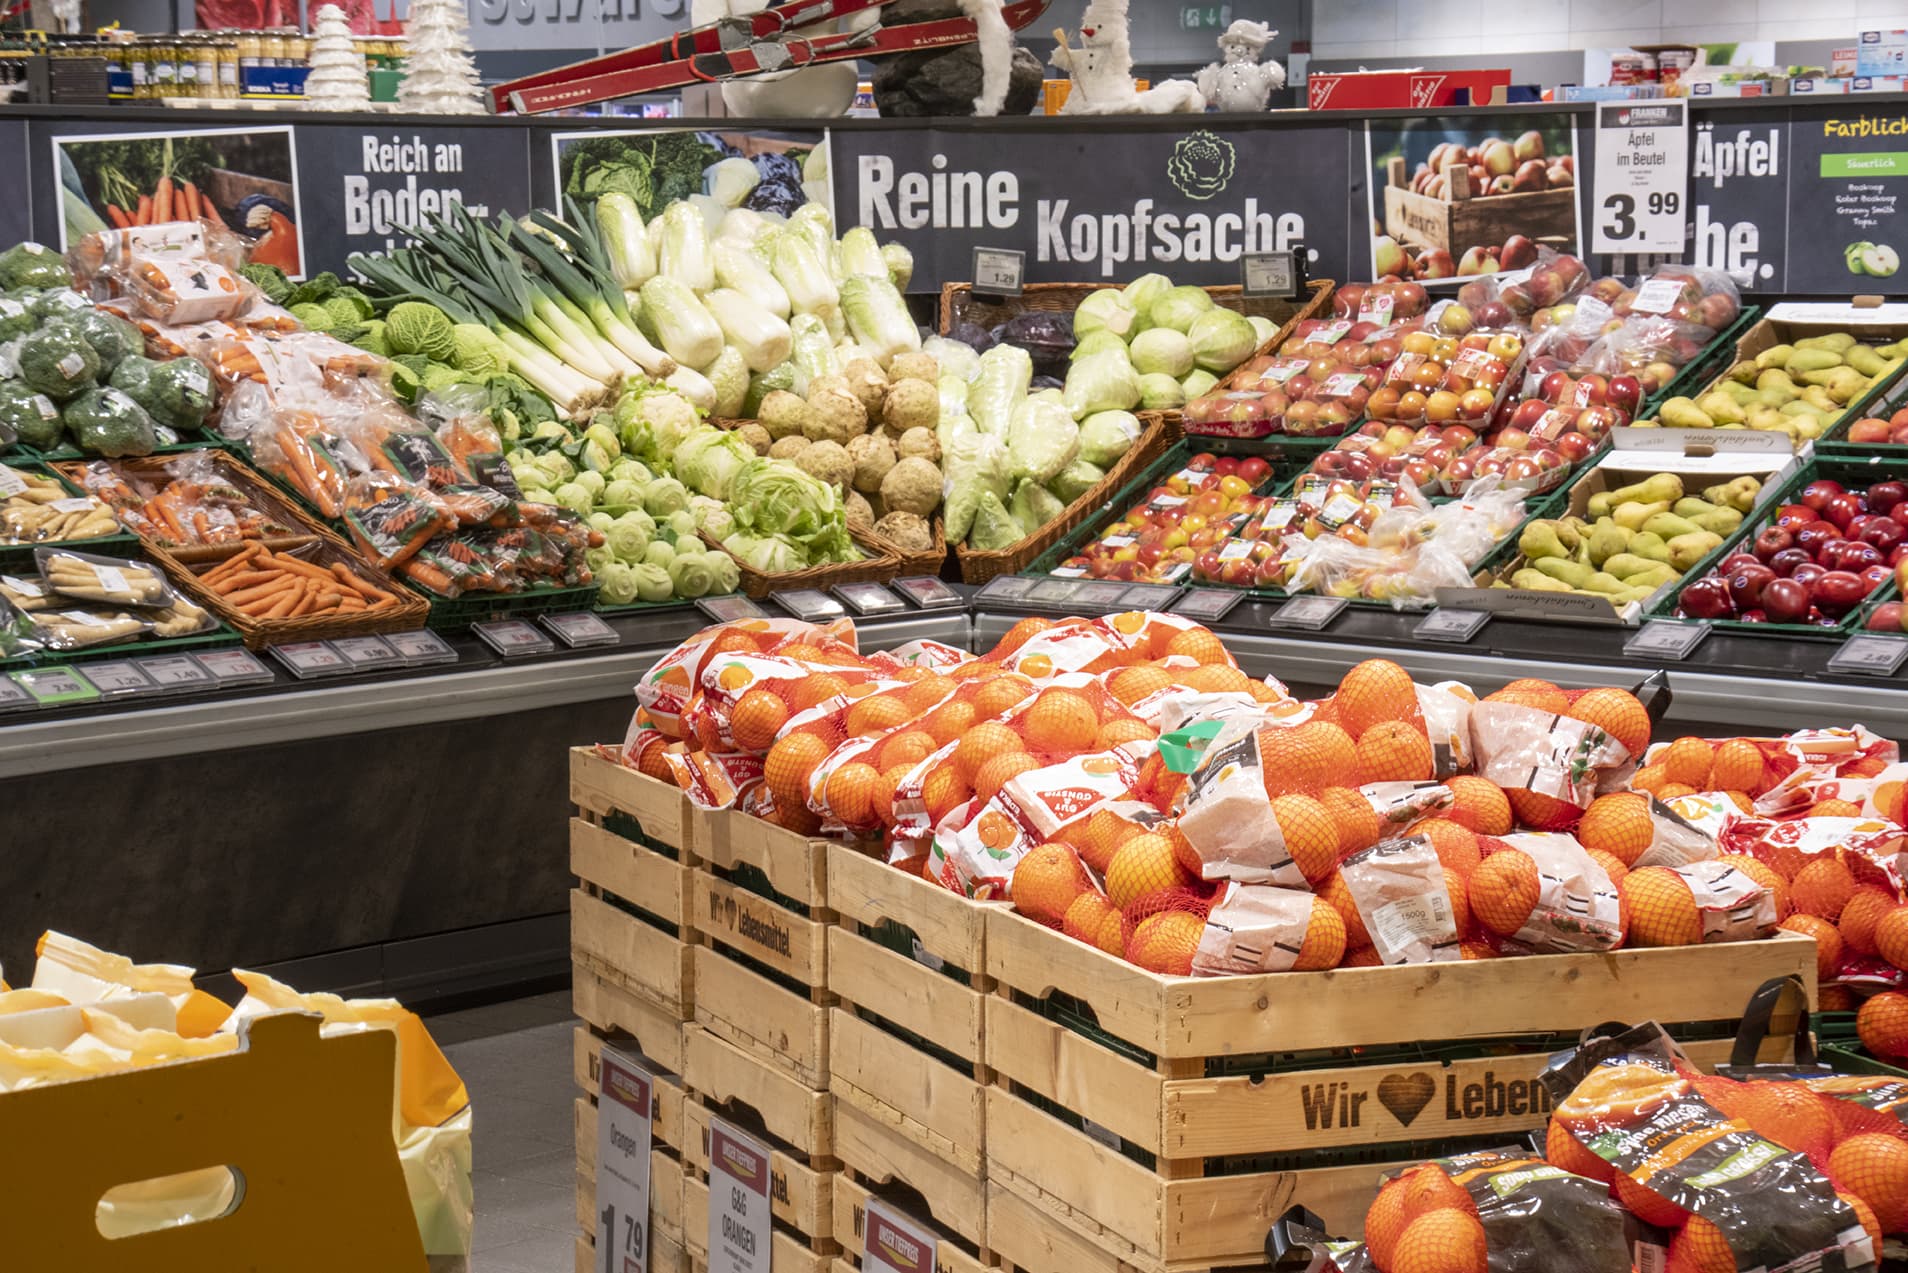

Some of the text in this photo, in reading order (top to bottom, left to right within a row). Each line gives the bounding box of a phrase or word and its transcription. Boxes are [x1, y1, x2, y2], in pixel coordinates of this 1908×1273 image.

[362, 135, 463, 172] Reich an
[1627, 130, 1655, 147] Äpfel
[1693, 121, 1779, 188] Äpfel
[1617, 152, 1666, 166] im Beutel
[1846, 158, 1896, 169] Säuerlich
[344, 175, 489, 235] Boden-
[858, 153, 1020, 230] Reine
[1848, 183, 1885, 195] Boskoop
[1861, 195, 1897, 206] Boskoop
[1836, 205, 1896, 218] Granny Smith
[1852, 217, 1878, 229] Topaz
[1036, 198, 1320, 277] Kopfsache.
[1054, 802, 1078, 813] GUT
[1301, 1072, 1552, 1130] Wir Leben
[610, 1122, 637, 1159] Orangen
[731, 1186, 747, 1217] G&G
[624, 1213, 643, 1260] 79
[722, 1213, 756, 1257] ORANGEN
[878, 1223, 919, 1264] UNSER TIEFPREIS
